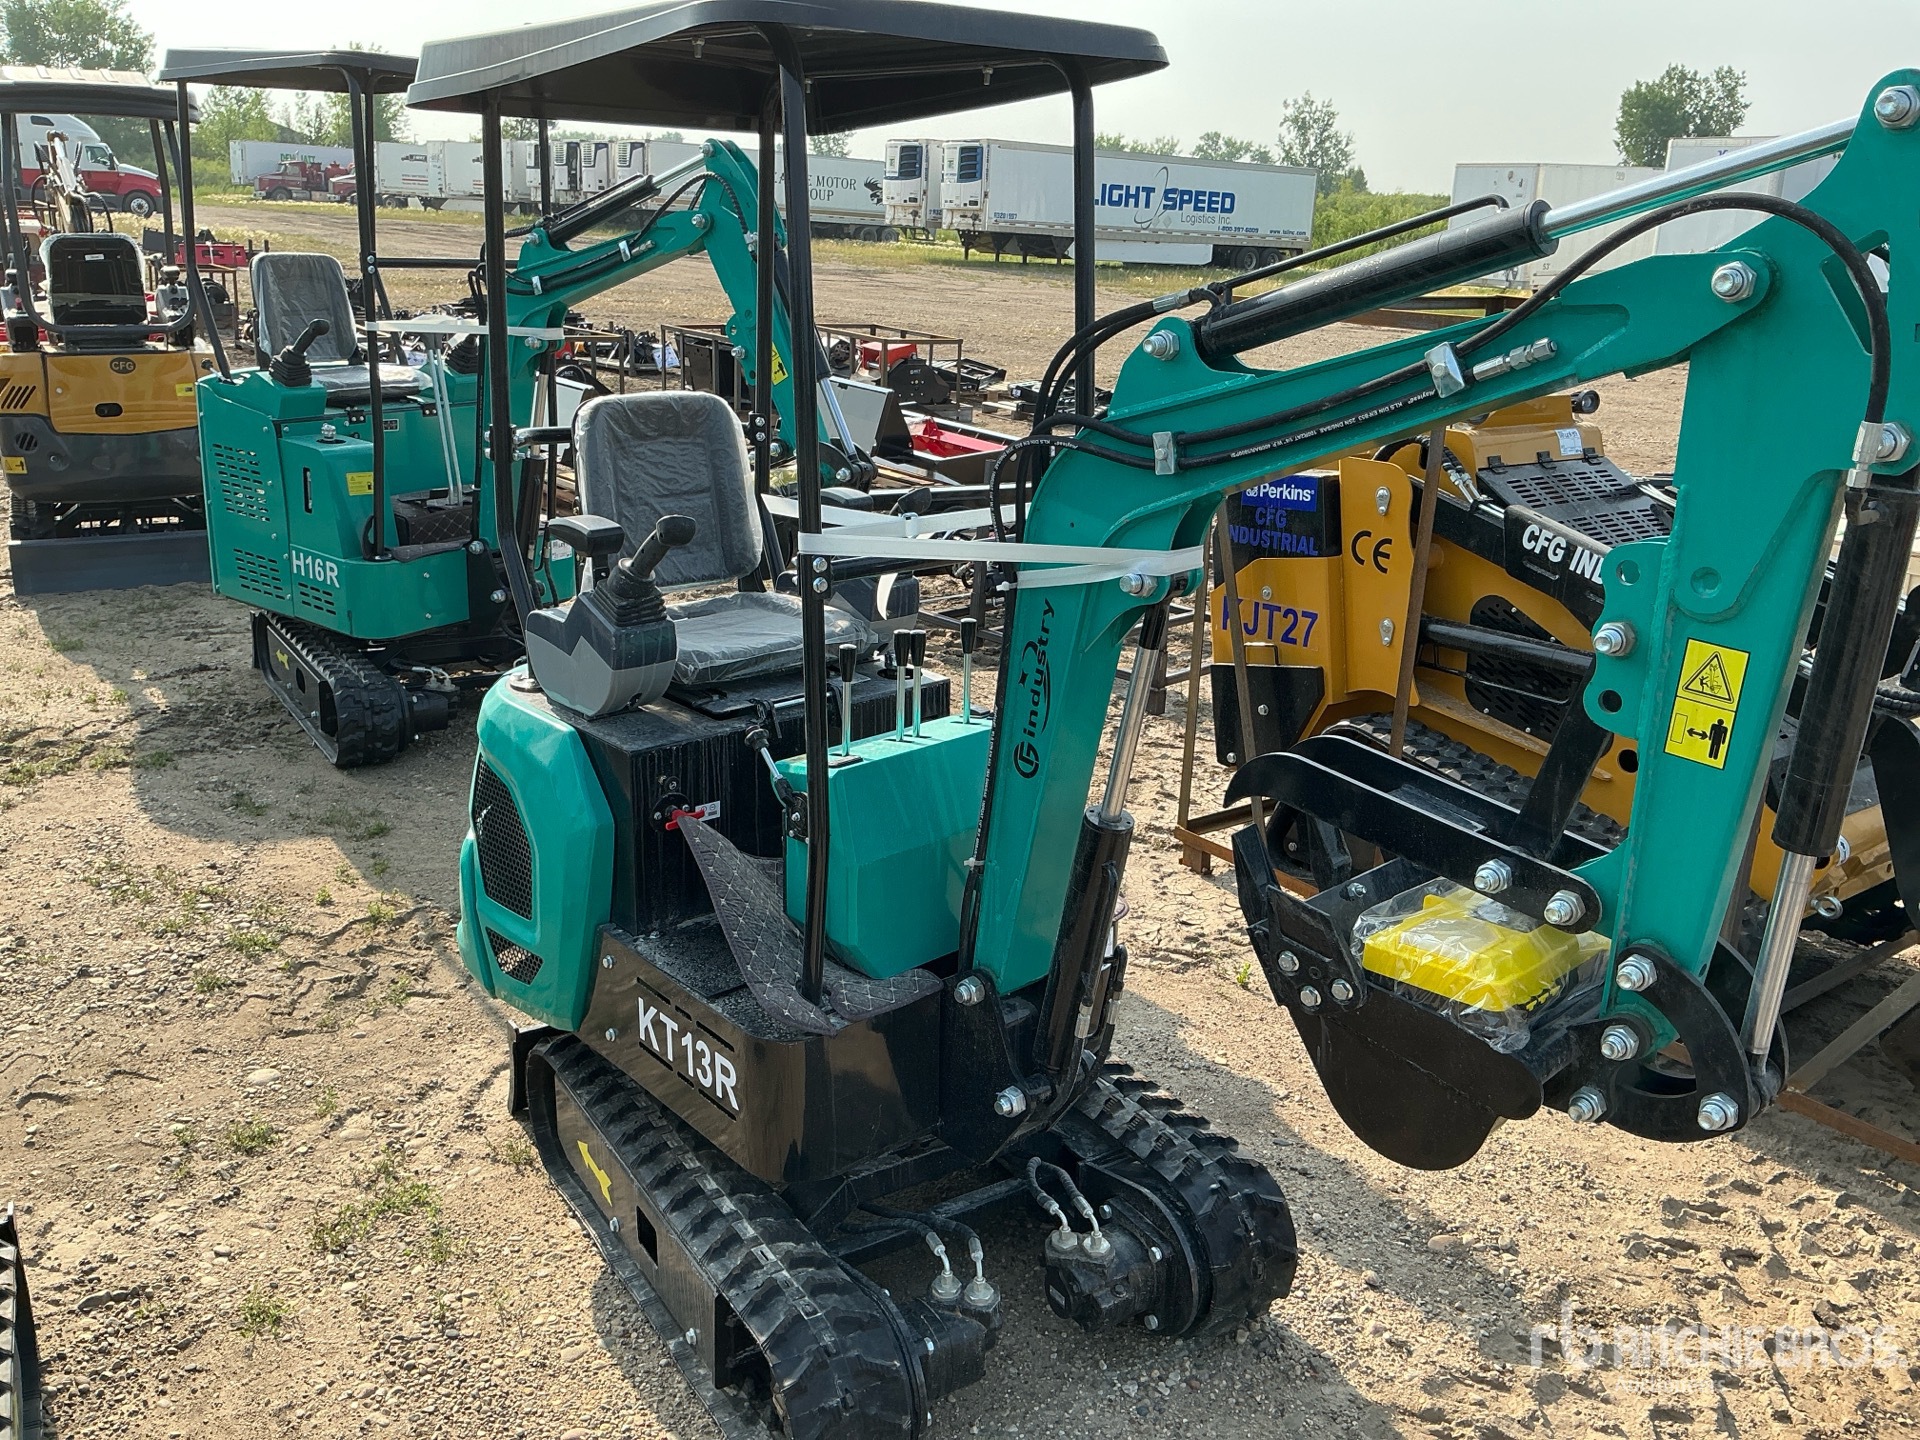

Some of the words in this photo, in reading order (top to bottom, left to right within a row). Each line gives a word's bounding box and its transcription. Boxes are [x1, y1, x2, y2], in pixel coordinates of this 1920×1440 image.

[809, 188, 834, 201] OUP
[816, 175, 857, 190] MOTOR
[1094, 183, 1156, 209] IGHT
[1162, 187, 1236, 214] SPEED
[1180, 212, 1216, 226] Logistics
[1218, 213, 1232, 225] Inc.
[111, 361, 135, 370] CFG
[1255, 507, 1287, 529] CFG
[1229, 525, 1319, 556] NDUSTRIAL
[1351, 530, 1393, 574] CE
[1522, 524, 1567, 563] CFG
[291, 550, 340, 588] H16R
[637, 997, 739, 1111] KT13R
